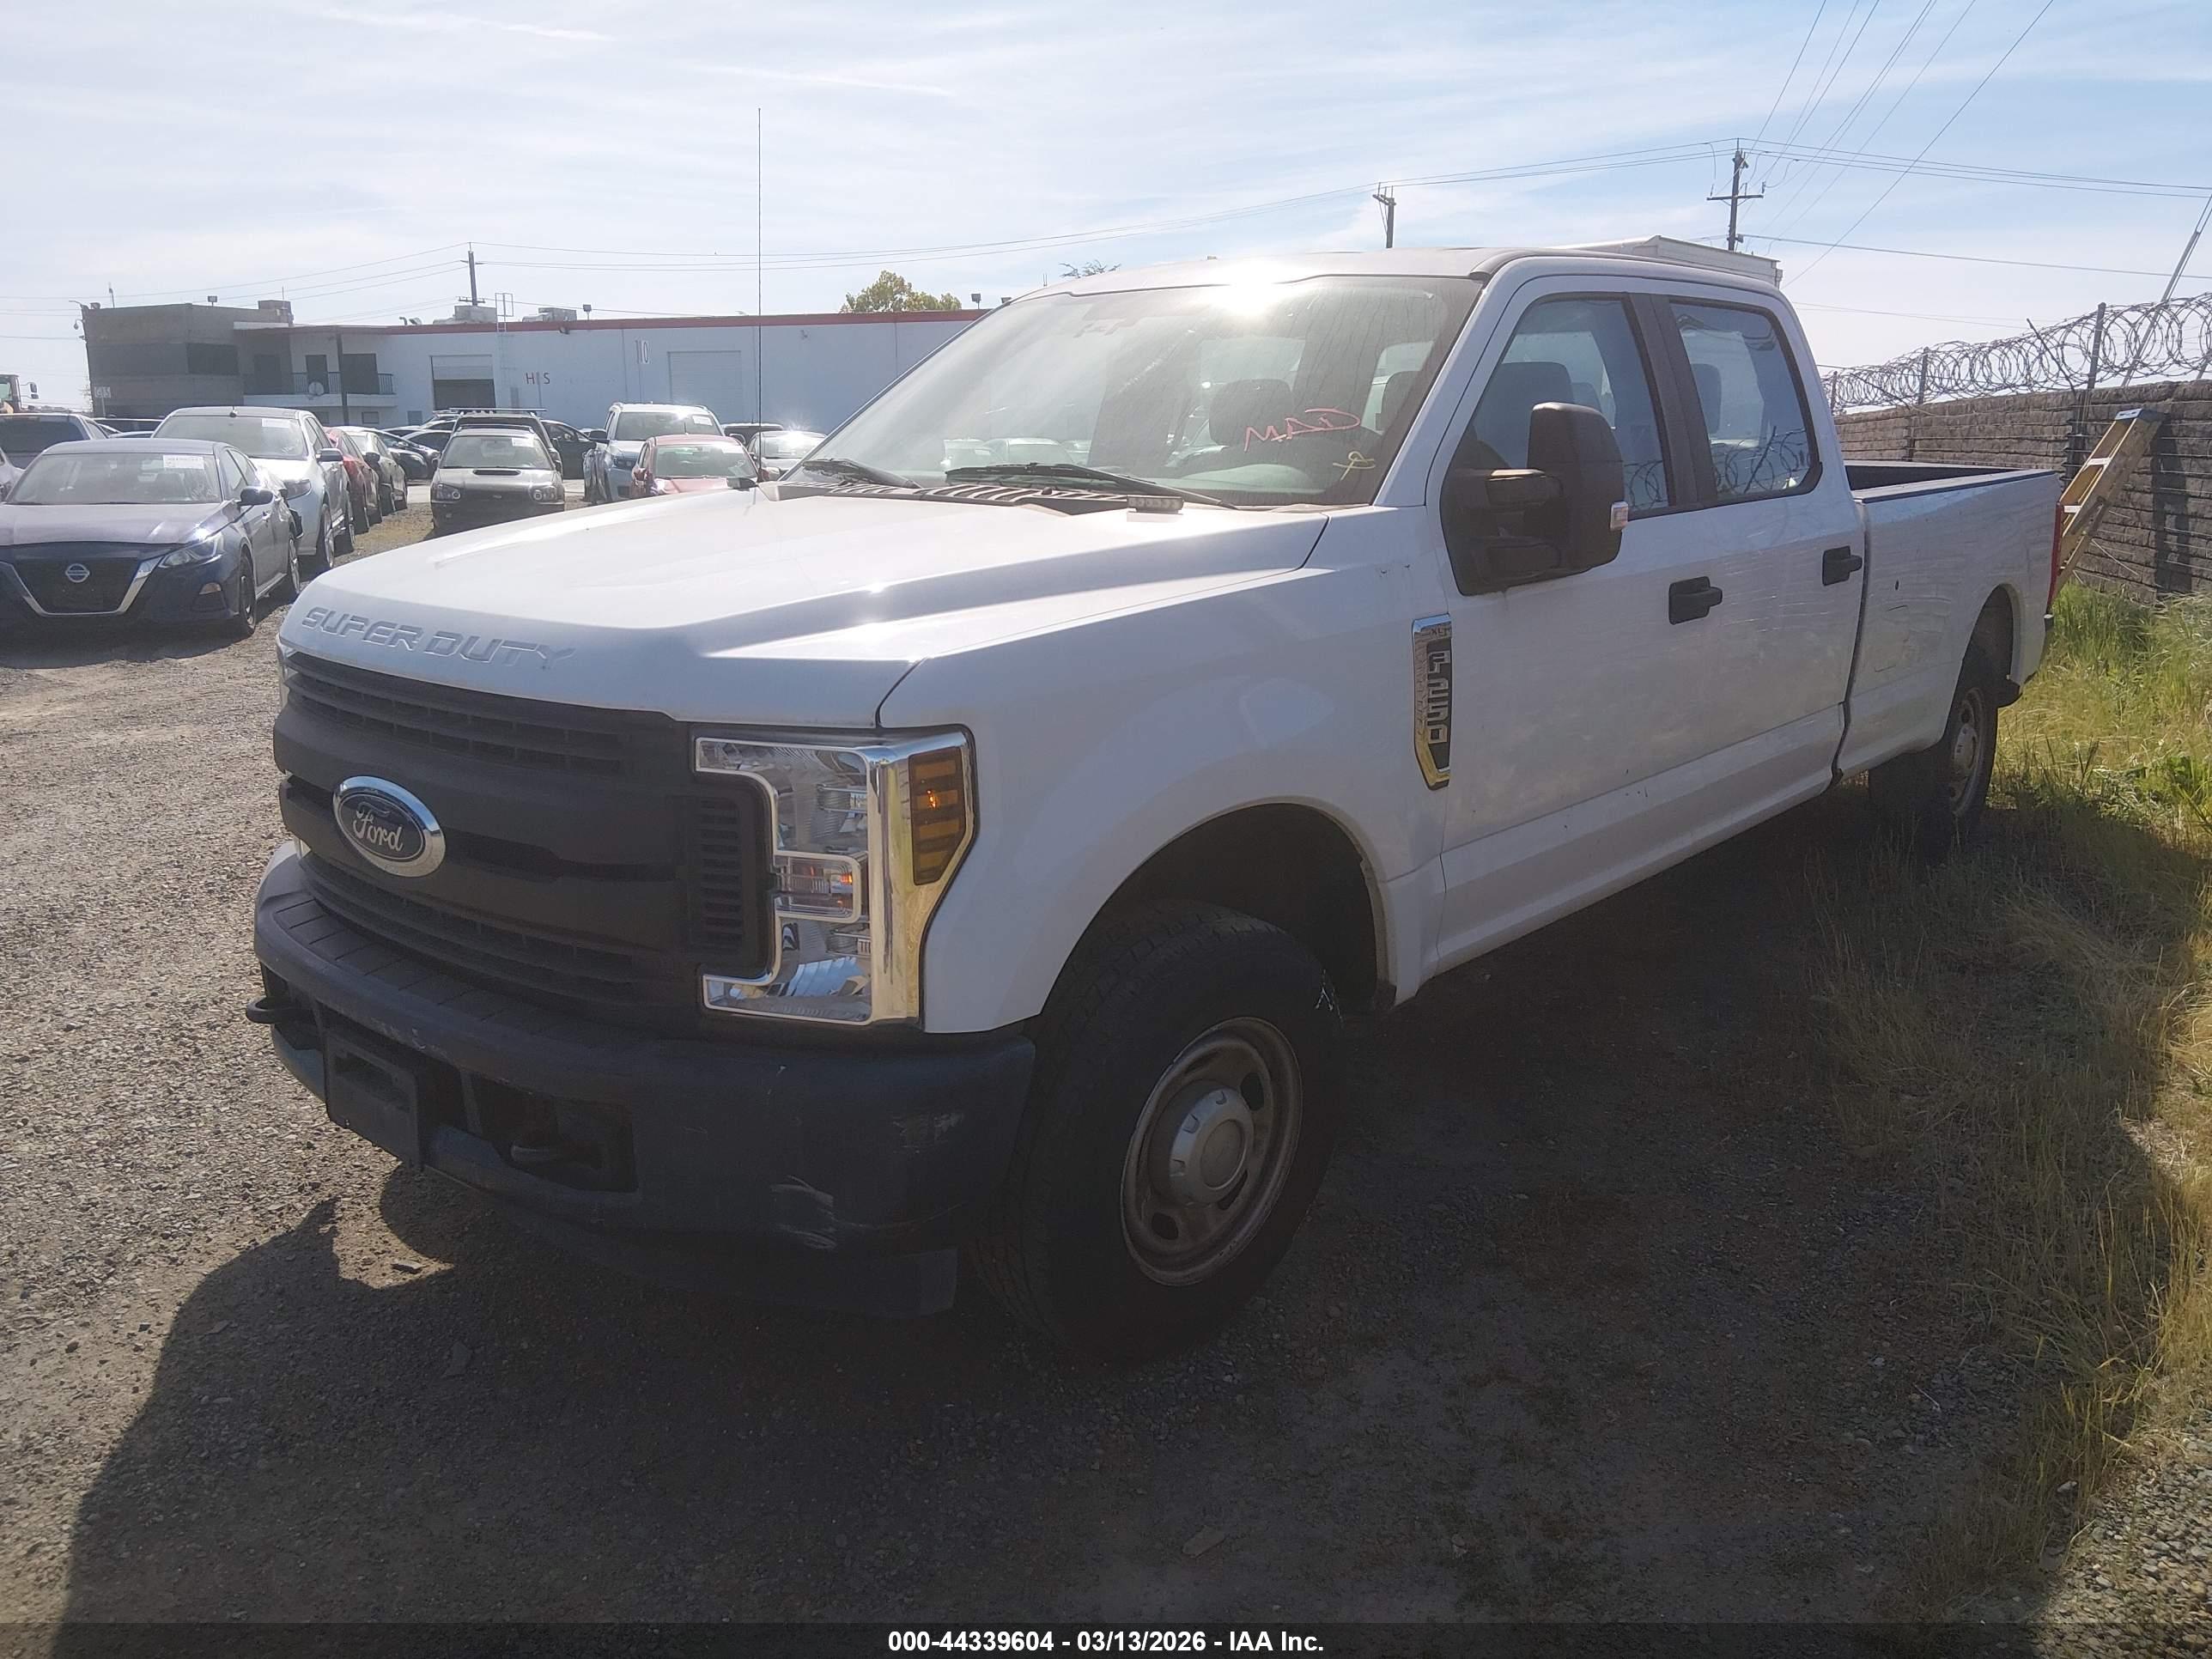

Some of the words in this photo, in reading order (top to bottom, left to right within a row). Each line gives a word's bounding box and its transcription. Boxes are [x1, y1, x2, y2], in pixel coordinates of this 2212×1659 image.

[301, 605, 425, 652] SUPER
[423, 629, 577, 671] DUTY
[352, 800, 404, 852] Ford
